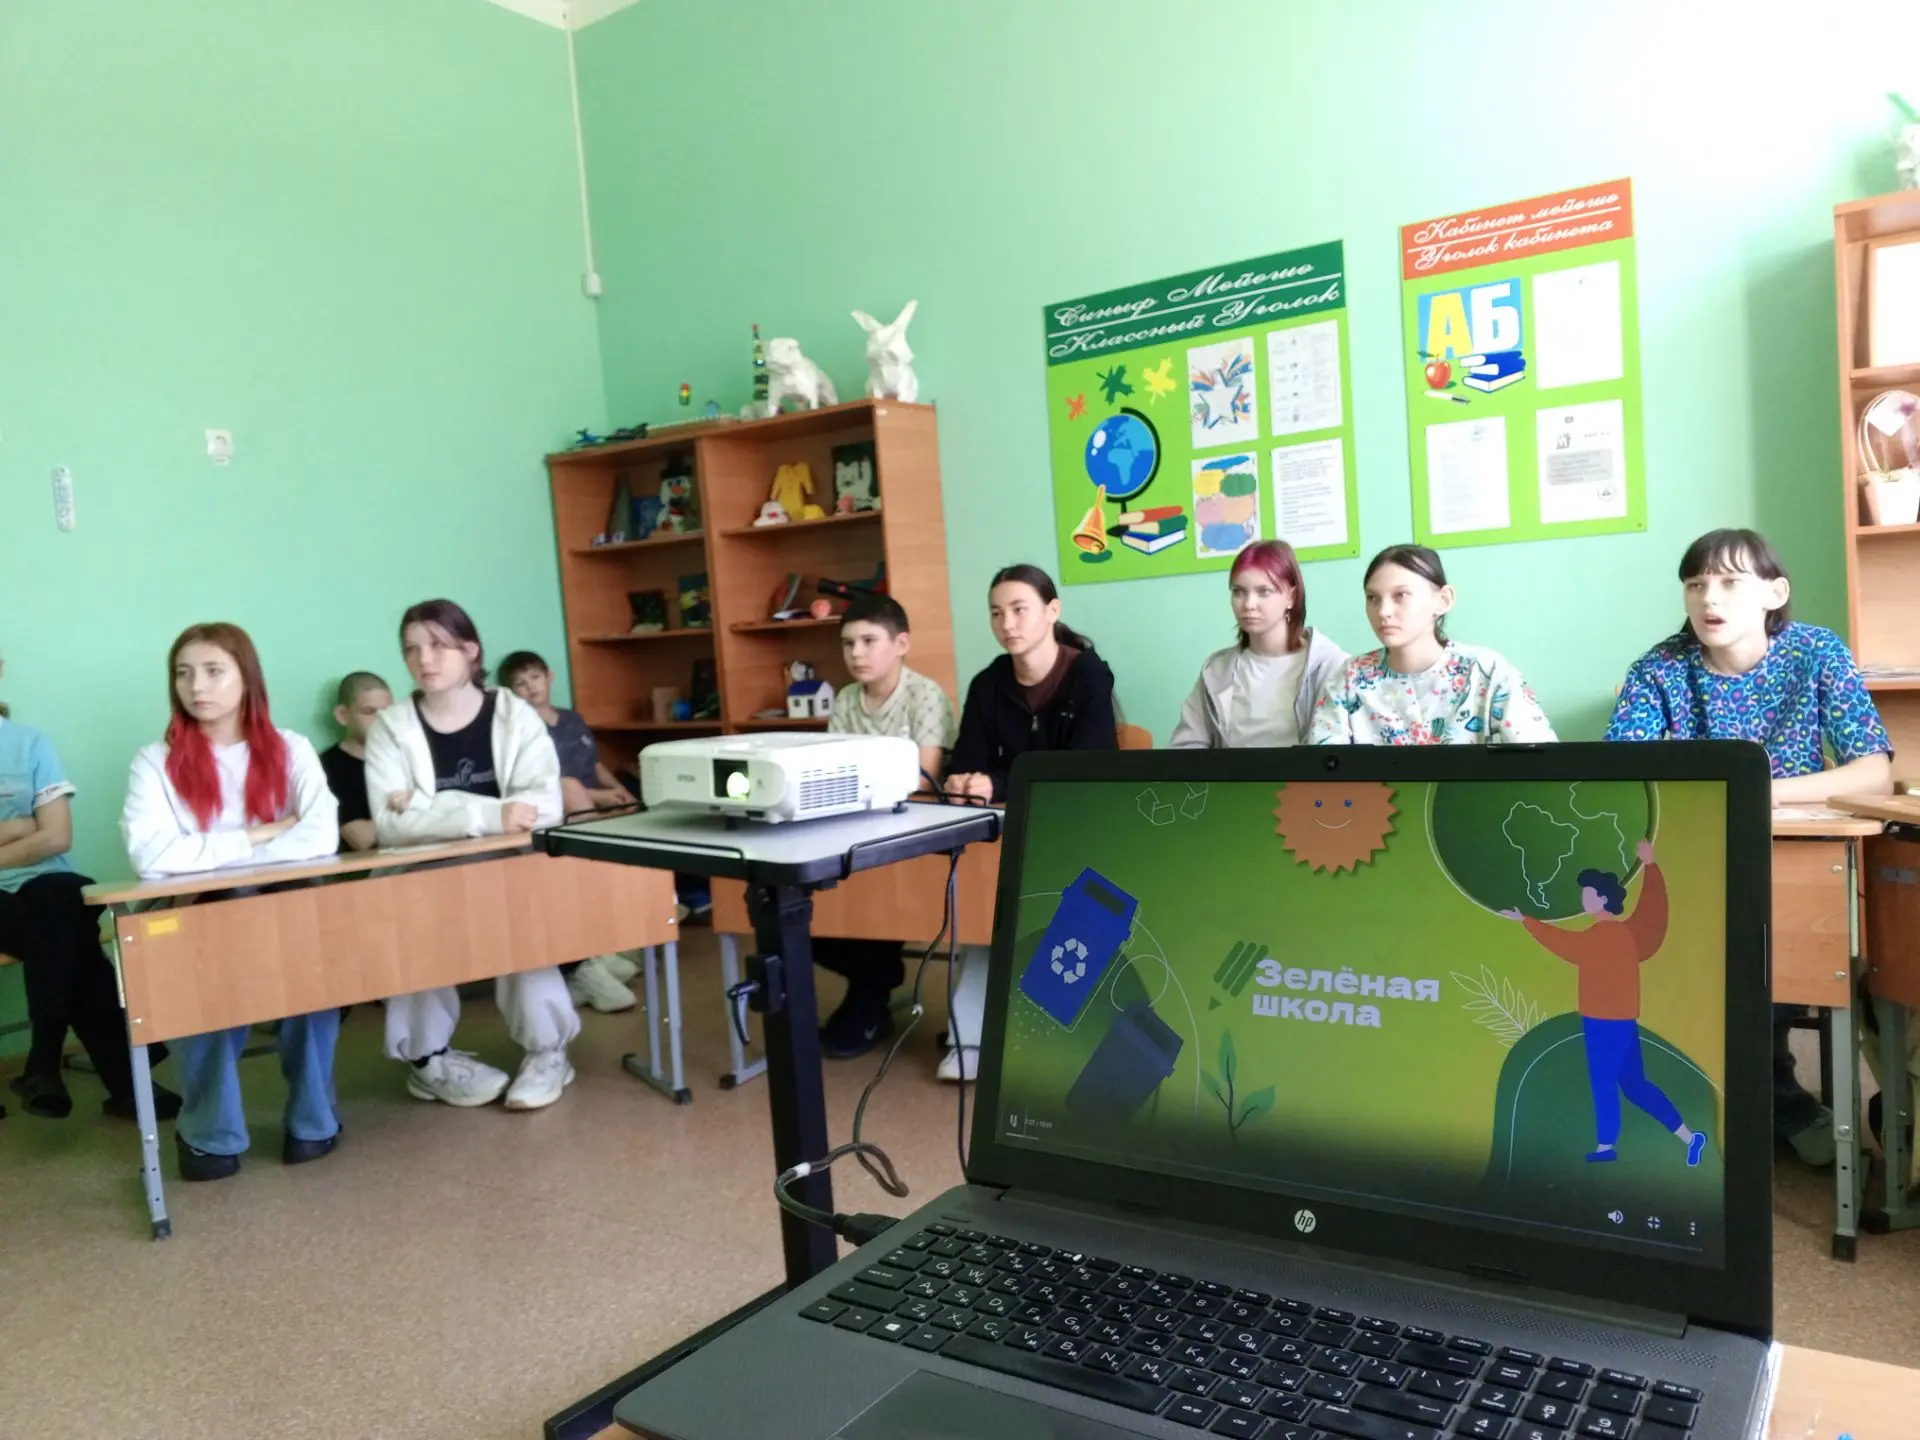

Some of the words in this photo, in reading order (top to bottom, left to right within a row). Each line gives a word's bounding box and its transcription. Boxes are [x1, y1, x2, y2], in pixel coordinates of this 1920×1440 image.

[1413, 212, 1526, 245] Кабинет
[1414, 234, 1500, 271] Уголок
[1503, 219, 1615, 252] кабинета
[1054, 297, 1158, 328] Синыф
[1048, 314, 1207, 358] Классный
[1212, 281, 1341, 328] Уголок
[1425, 282, 1521, 360] АБ
[1255, 958, 1440, 1003] Зелёная
[1252, 993, 1382, 1028] школа
[1296, 1209, 1314, 1233] hp
[936, 1262, 949, 1270] Q
[968, 1269, 985, 1278] W
[1003, 1278, 1017, 1286] E
[955, 1290, 968, 1298] S
[1040, 1286, 1053, 1295] R
[988, 1297, 1002, 1306] D
[1080, 1295, 1091, 1303] T
[911, 1303, 926, 1312] Z
[1025, 1307, 1040, 1315] F
[1118, 1304, 1129, 1312] Y
[946, 1312, 961, 1321] X
[1064, 1316, 1079, 1325] G
[1155, 1313, 1169, 1322] U
[984, 1322, 998, 1330] C
[1102, 1325, 1118, 1335] H
[1024, 1331, 1038, 1339] V
[1238, 1333, 1253, 1342] O
[1060, 1341, 1074, 1350] B
[1281, 1344, 1297, 1352] P
[1100, 1351, 1117, 1361] N
[1185, 1346, 1201, 1357] K
[1229, 1357, 1240, 1368] L
[1141, 1363, 1159, 1373] M
[1475, 1418, 1489, 1430] 4
[1598, 1418, 1612, 1428] 9
